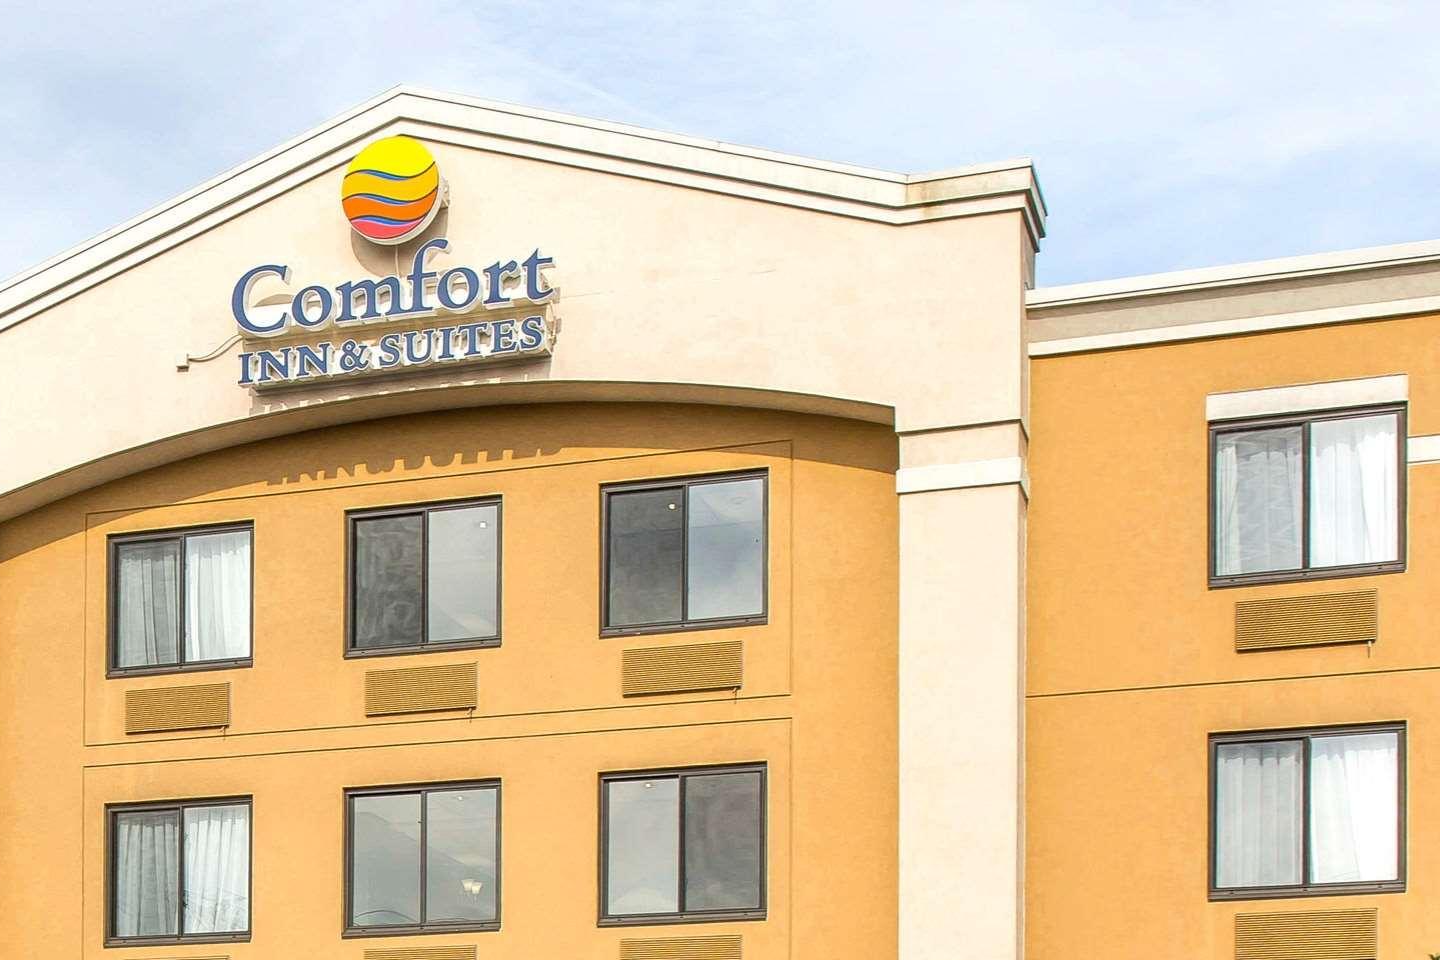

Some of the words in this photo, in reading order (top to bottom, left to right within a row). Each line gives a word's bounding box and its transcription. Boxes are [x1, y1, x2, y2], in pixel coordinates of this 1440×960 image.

[231, 239, 554, 332] Comfort
[237, 343, 330, 385] INN
[339, 340, 370, 371] &
[379, 316, 544, 367] SUITES
